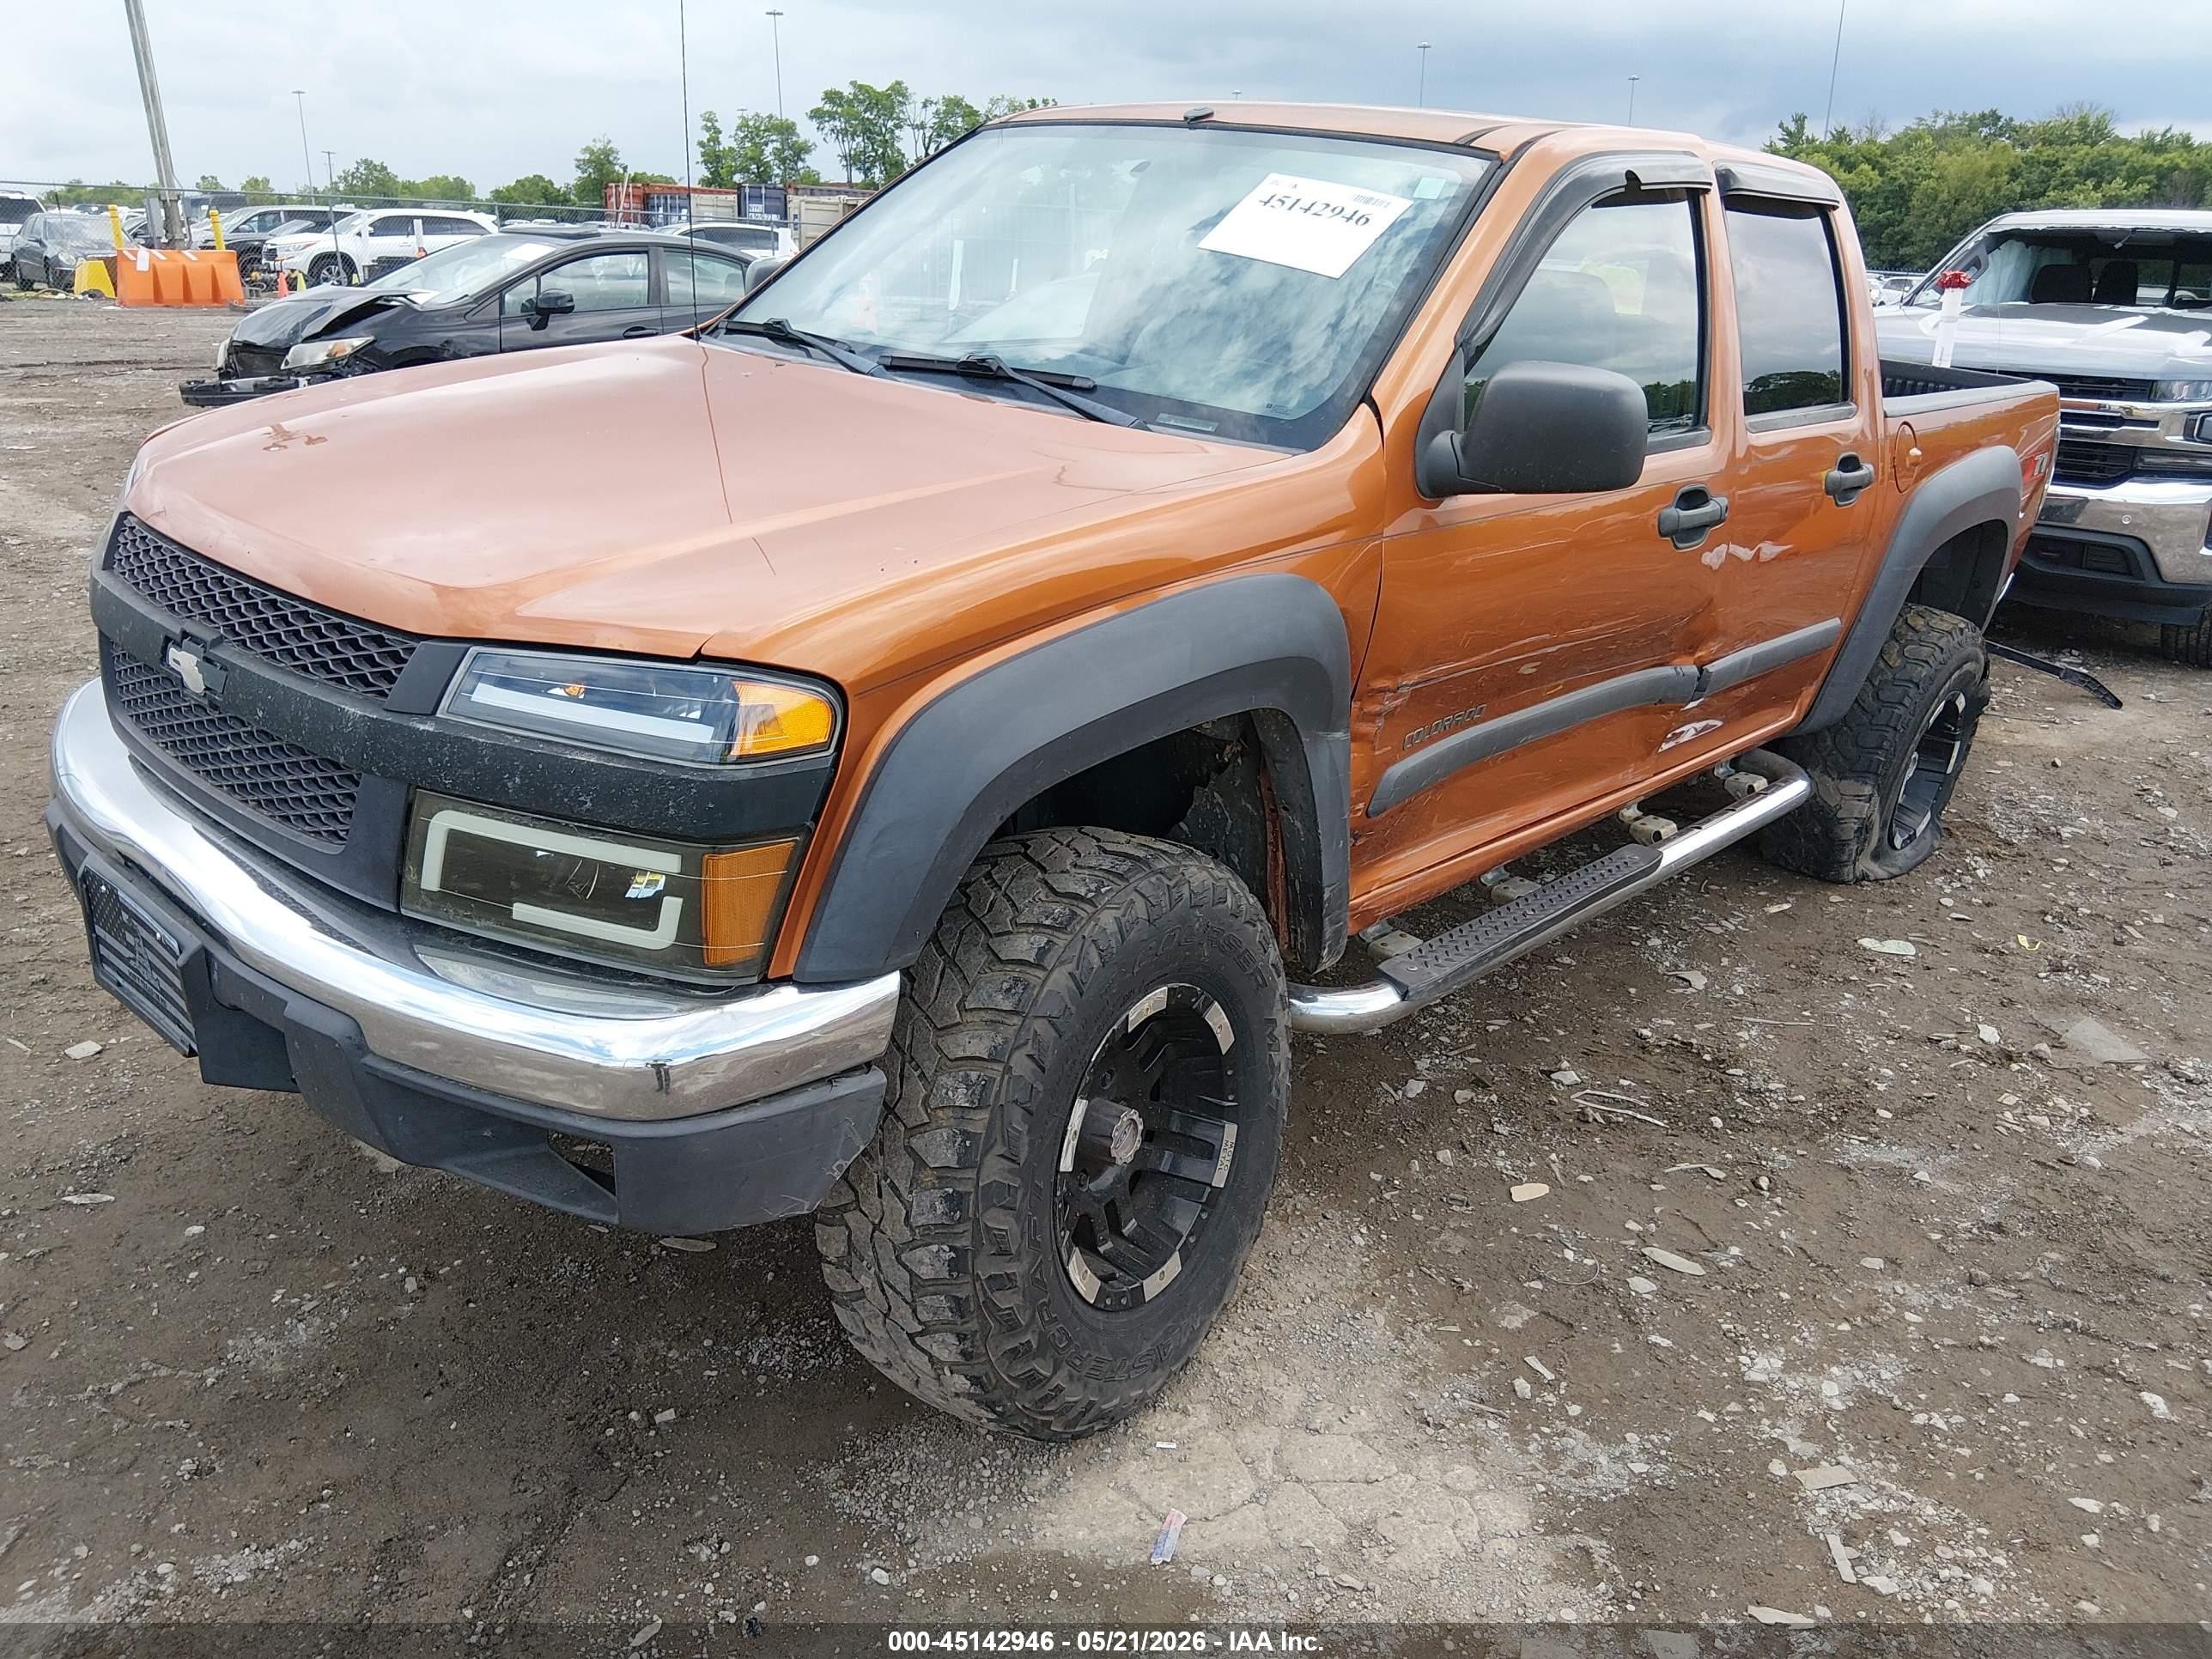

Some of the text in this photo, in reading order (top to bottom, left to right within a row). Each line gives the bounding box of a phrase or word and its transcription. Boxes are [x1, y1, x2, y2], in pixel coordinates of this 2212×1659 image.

[1259, 194, 1373, 227] 45142946
[1402, 704, 1487, 750] COLORADO
[1218, 1140, 1229, 1170] METAL
[1224, 1141, 1234, 1172] MOTO
[1028, 1162, 1203, 1383] MASTERCRAFT
